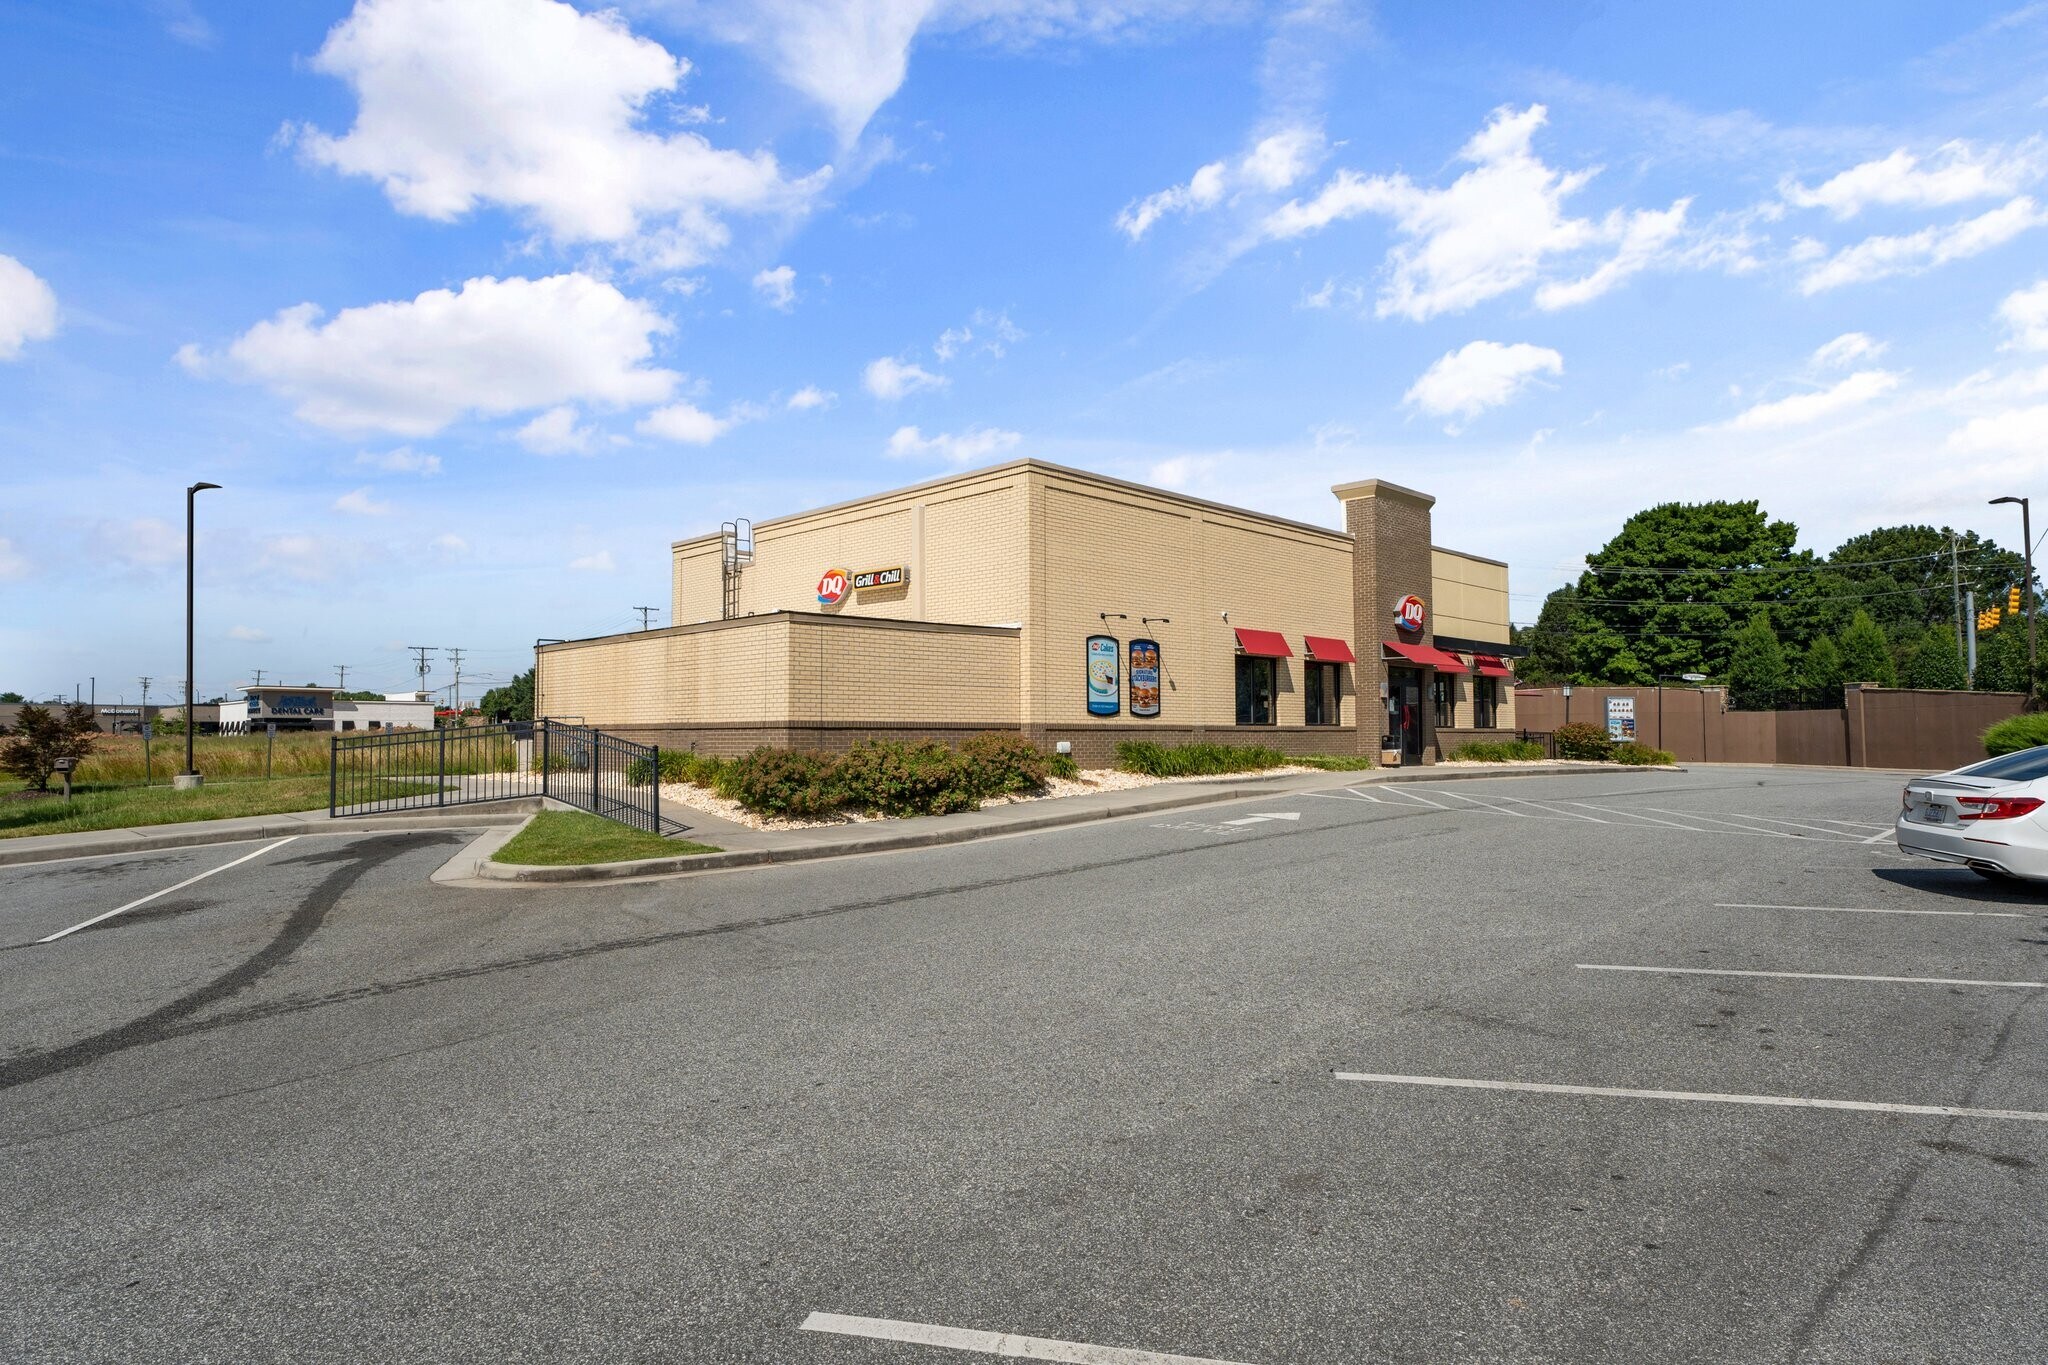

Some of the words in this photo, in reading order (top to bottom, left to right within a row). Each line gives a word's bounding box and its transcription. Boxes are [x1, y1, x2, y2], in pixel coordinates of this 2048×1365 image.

[821, 575, 843, 596] DQ
[1405, 602, 1422, 623] DQ
[1100, 643, 1114, 653] Cakes
[271, 707, 302, 716] DENTAL
[304, 707, 325, 716] CARE
